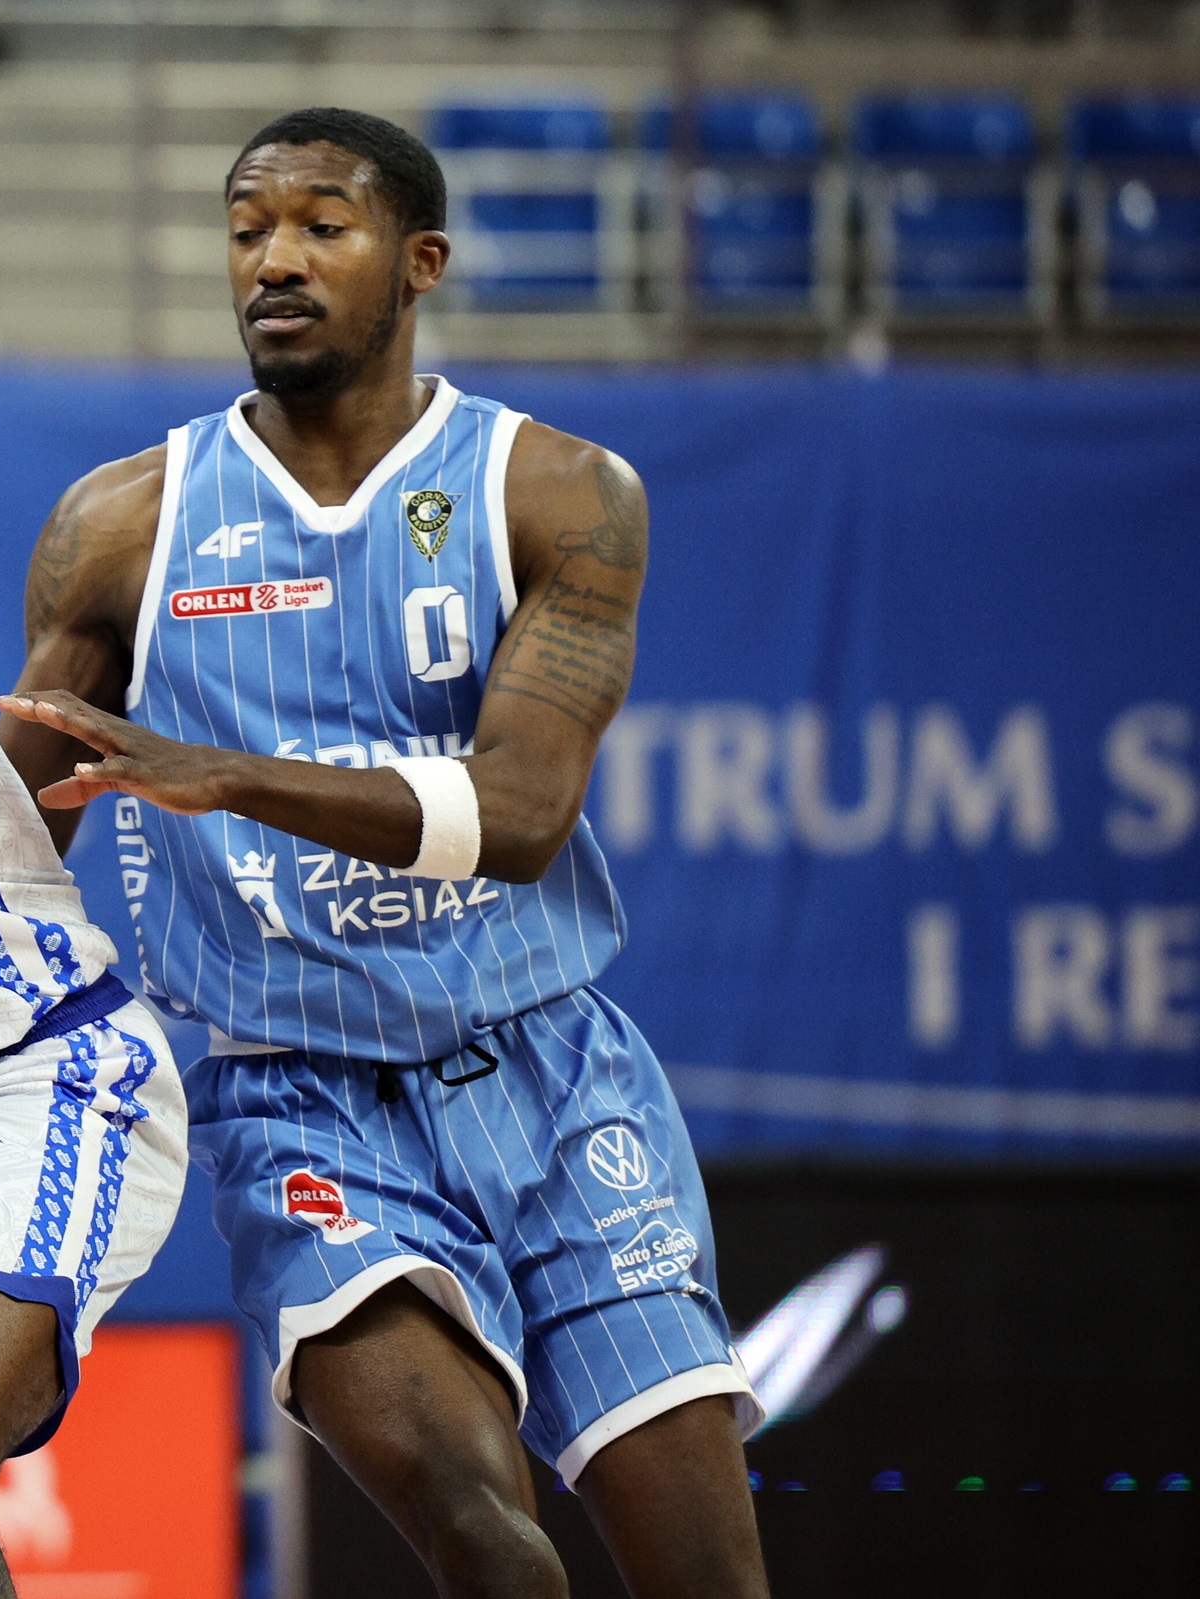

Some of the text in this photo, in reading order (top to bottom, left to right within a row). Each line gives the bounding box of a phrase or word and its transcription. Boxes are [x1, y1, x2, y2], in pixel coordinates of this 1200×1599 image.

[196, 521, 265, 559] 4F
[283, 582, 325, 594] Basket
[176, 592, 246, 612] ORLEN
[284, 595, 310, 606] Liga
[403, 585, 471, 683] 0
[598, 703, 1059, 856] TRUM
[611, 1248, 651, 1270] Auto
